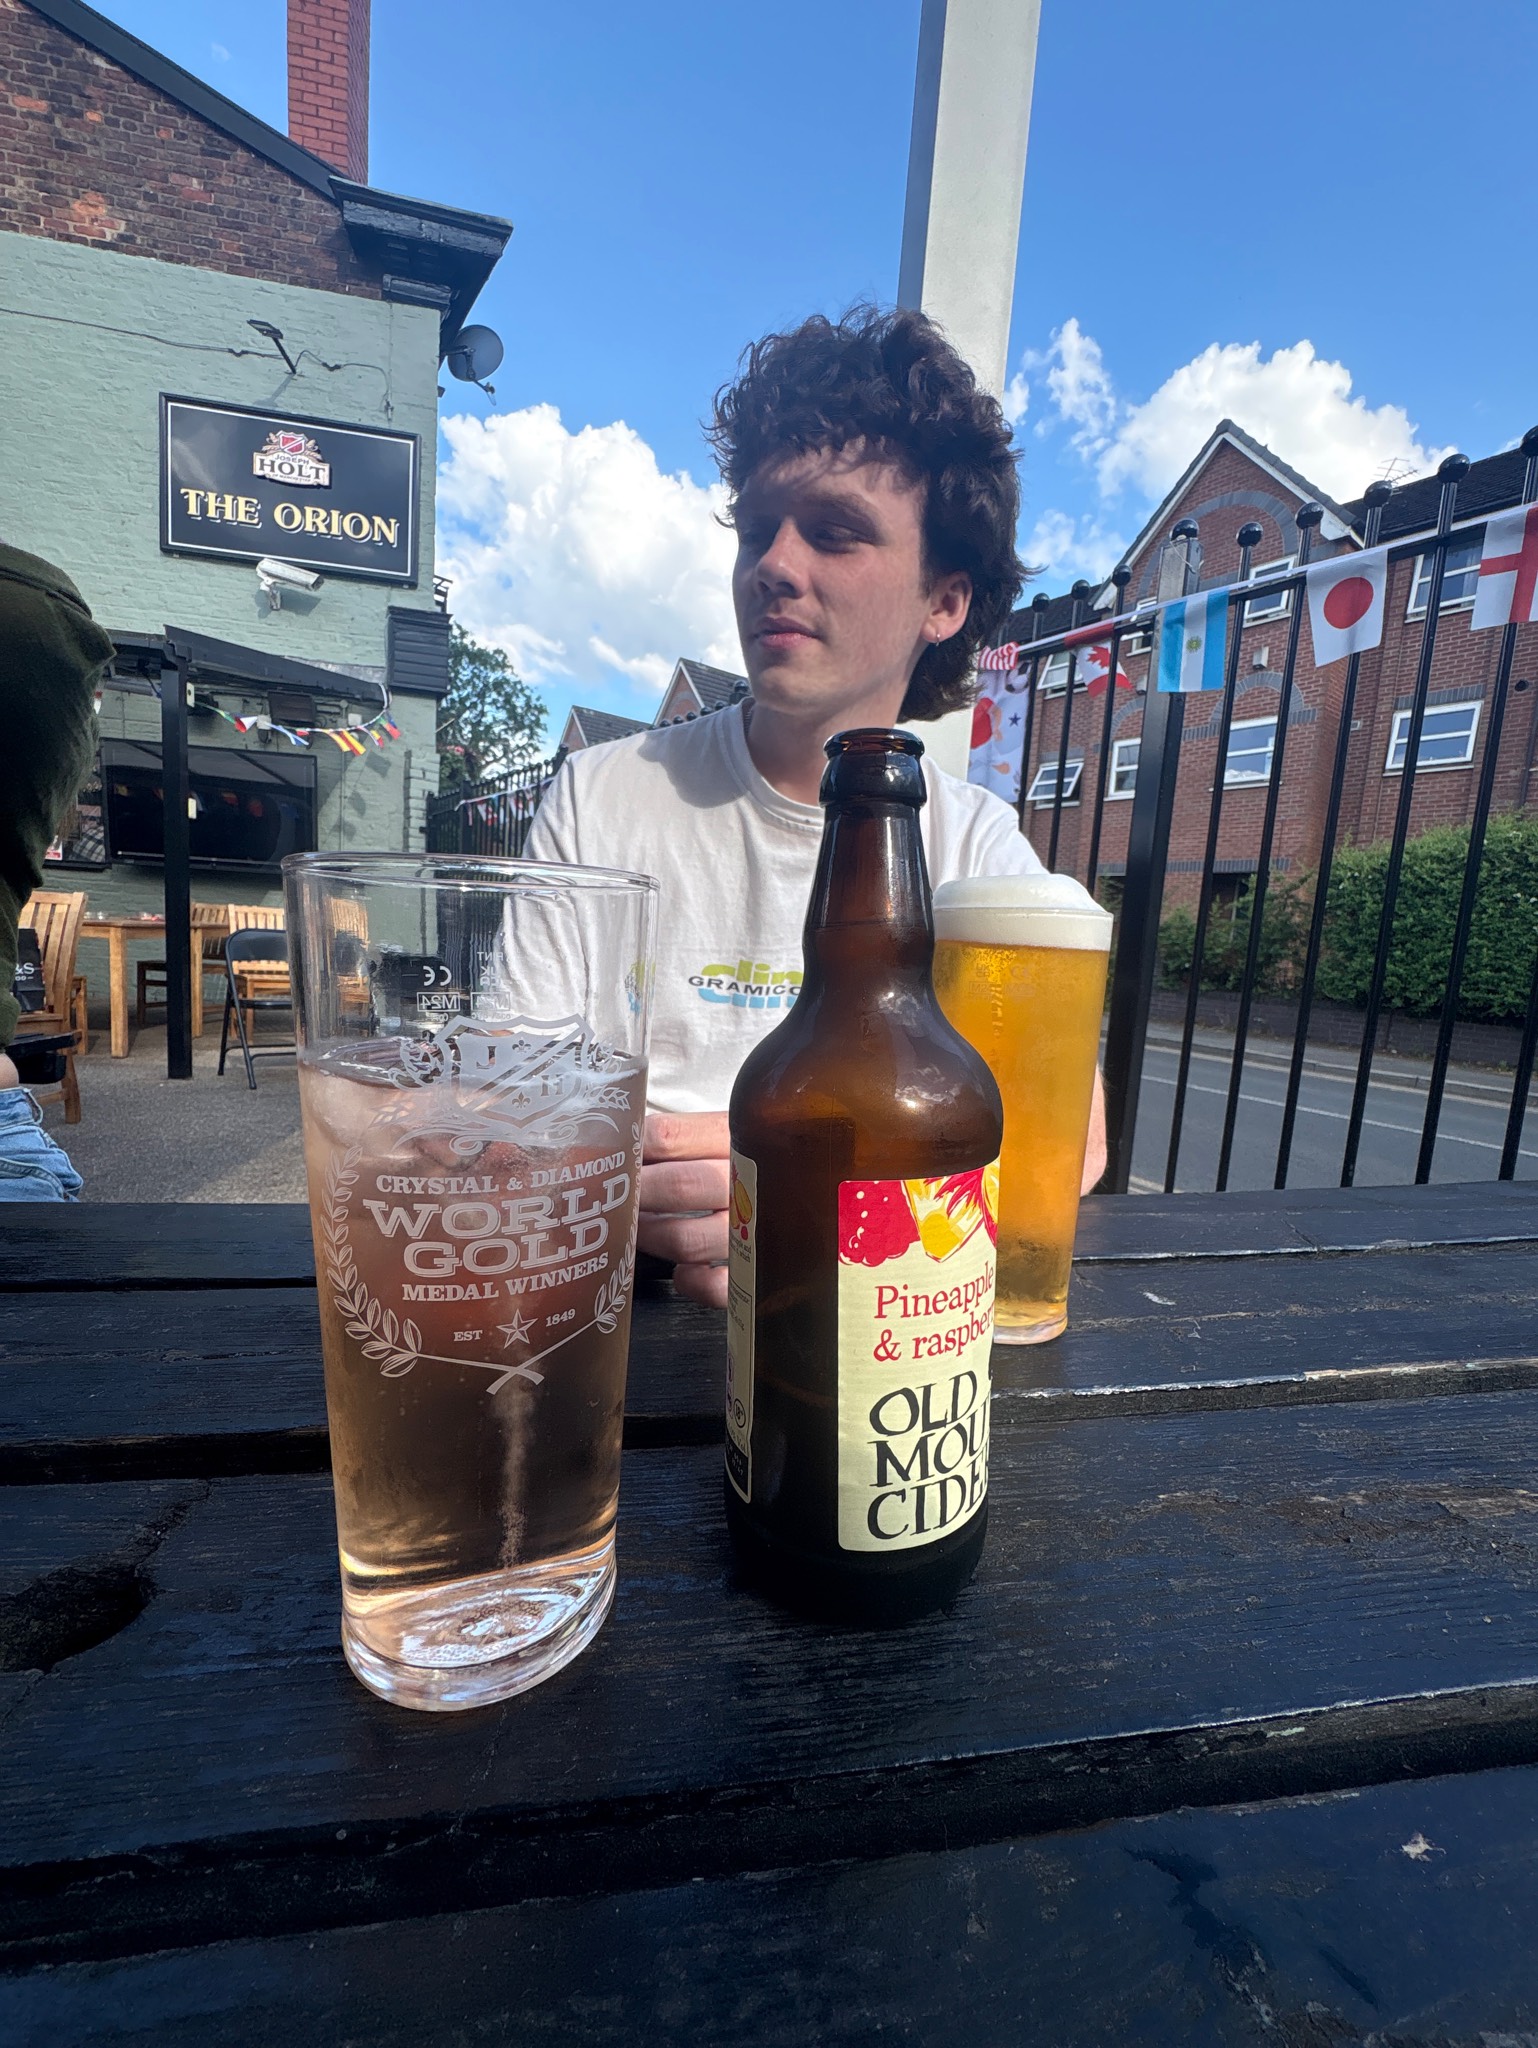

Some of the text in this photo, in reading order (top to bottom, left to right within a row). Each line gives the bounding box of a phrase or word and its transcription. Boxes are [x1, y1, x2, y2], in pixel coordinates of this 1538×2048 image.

[258, 458, 326, 480] HOLT
[274, 454, 310, 465] JOSEPH
[180, 488, 398, 546] THE ORION
[375, 1151, 626, 1195] CRYSTAL & DIAMOND
[362, 1173, 631, 1239] WORLD
[403, 1217, 609, 1278] GOLD
[402, 1251, 609, 1302] MEDAL WINNERS
[873, 1260, 994, 1319] Pineapple
[453, 1308, 576, 1342] EST 1849
[873, 1328, 902, 1362] &
[869, 1370, 978, 1437] OLD
[867, 1392, 991, 1488] MOU
